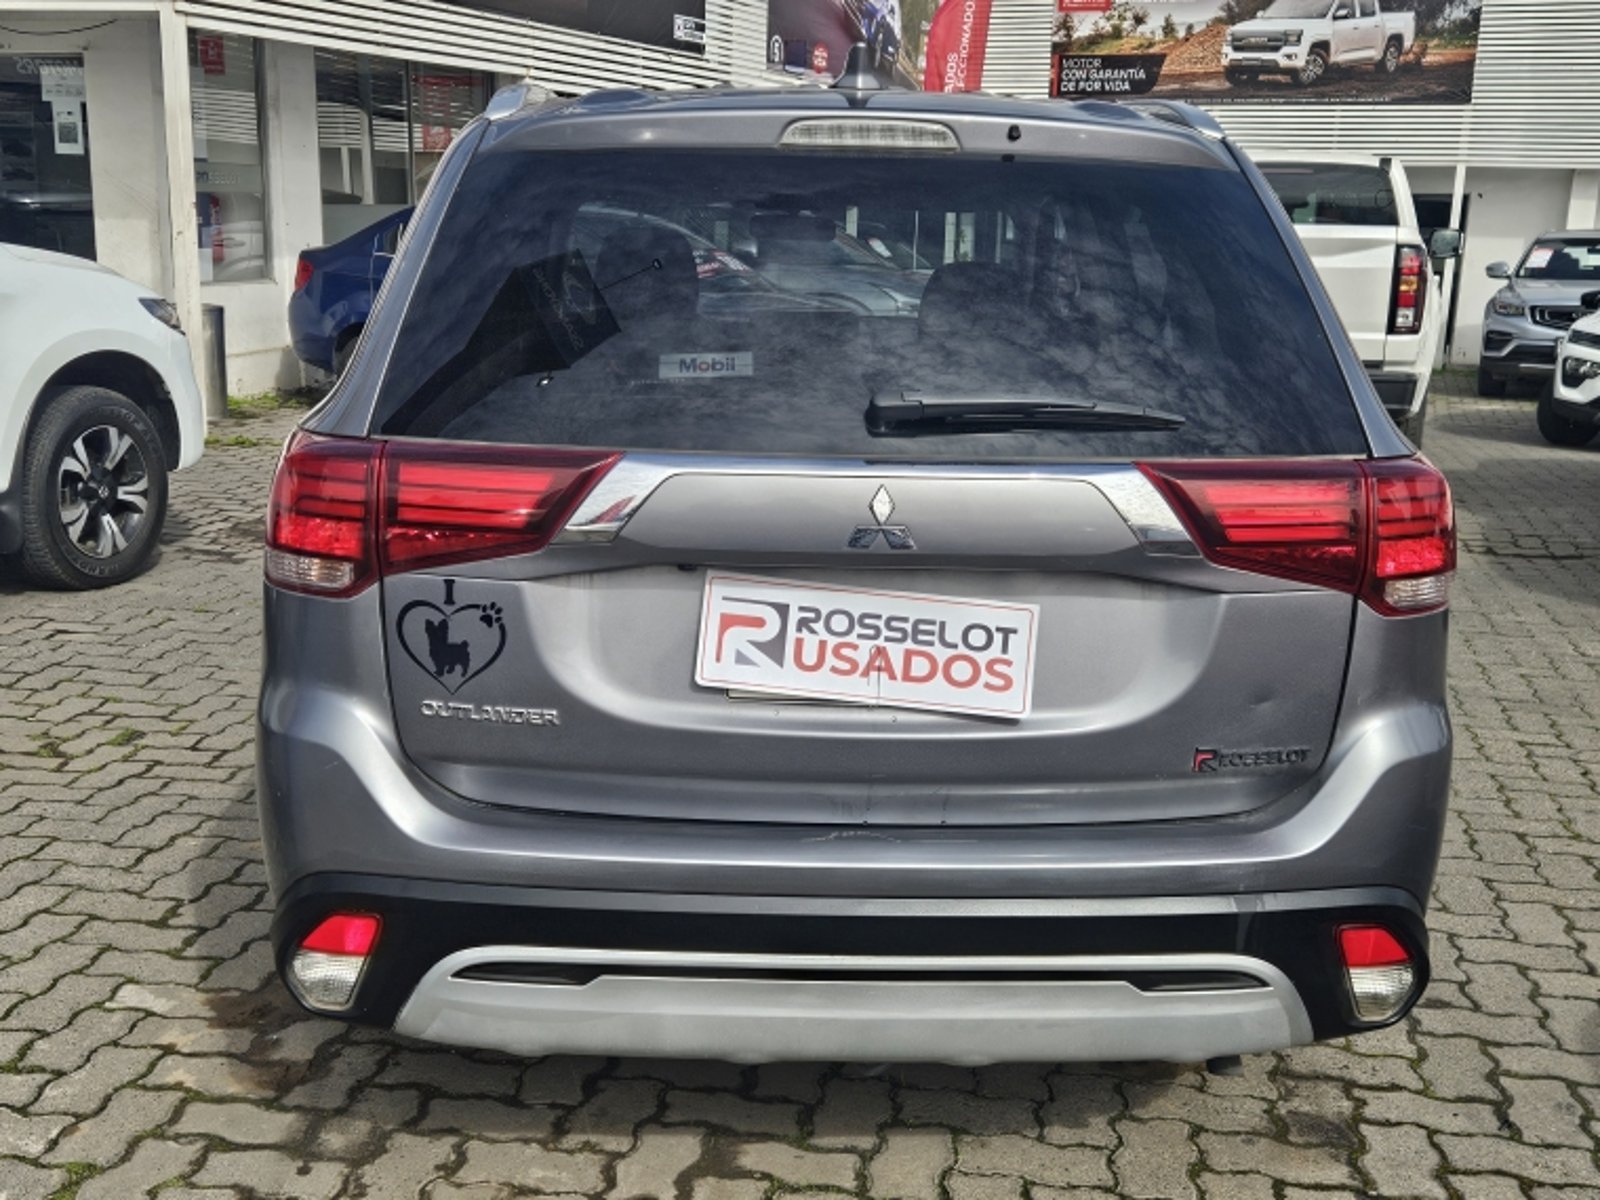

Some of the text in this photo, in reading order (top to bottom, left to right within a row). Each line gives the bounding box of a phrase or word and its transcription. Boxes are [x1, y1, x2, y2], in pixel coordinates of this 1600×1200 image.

[944, 52, 958, 93] ADOS
[1062, 58, 1102, 68] MOTOR
[1062, 66, 1146, 80] CON GARANTÍA
[1061, 81, 1131, 92] DE POR VIDA
[679, 357, 736, 373] Mobil
[443, 578, 456, 606] I
[795, 605, 1019, 655] ROSSELOT
[793, 637, 1015, 692] USADOS
[420, 699, 560, 726] OUTLANDER
